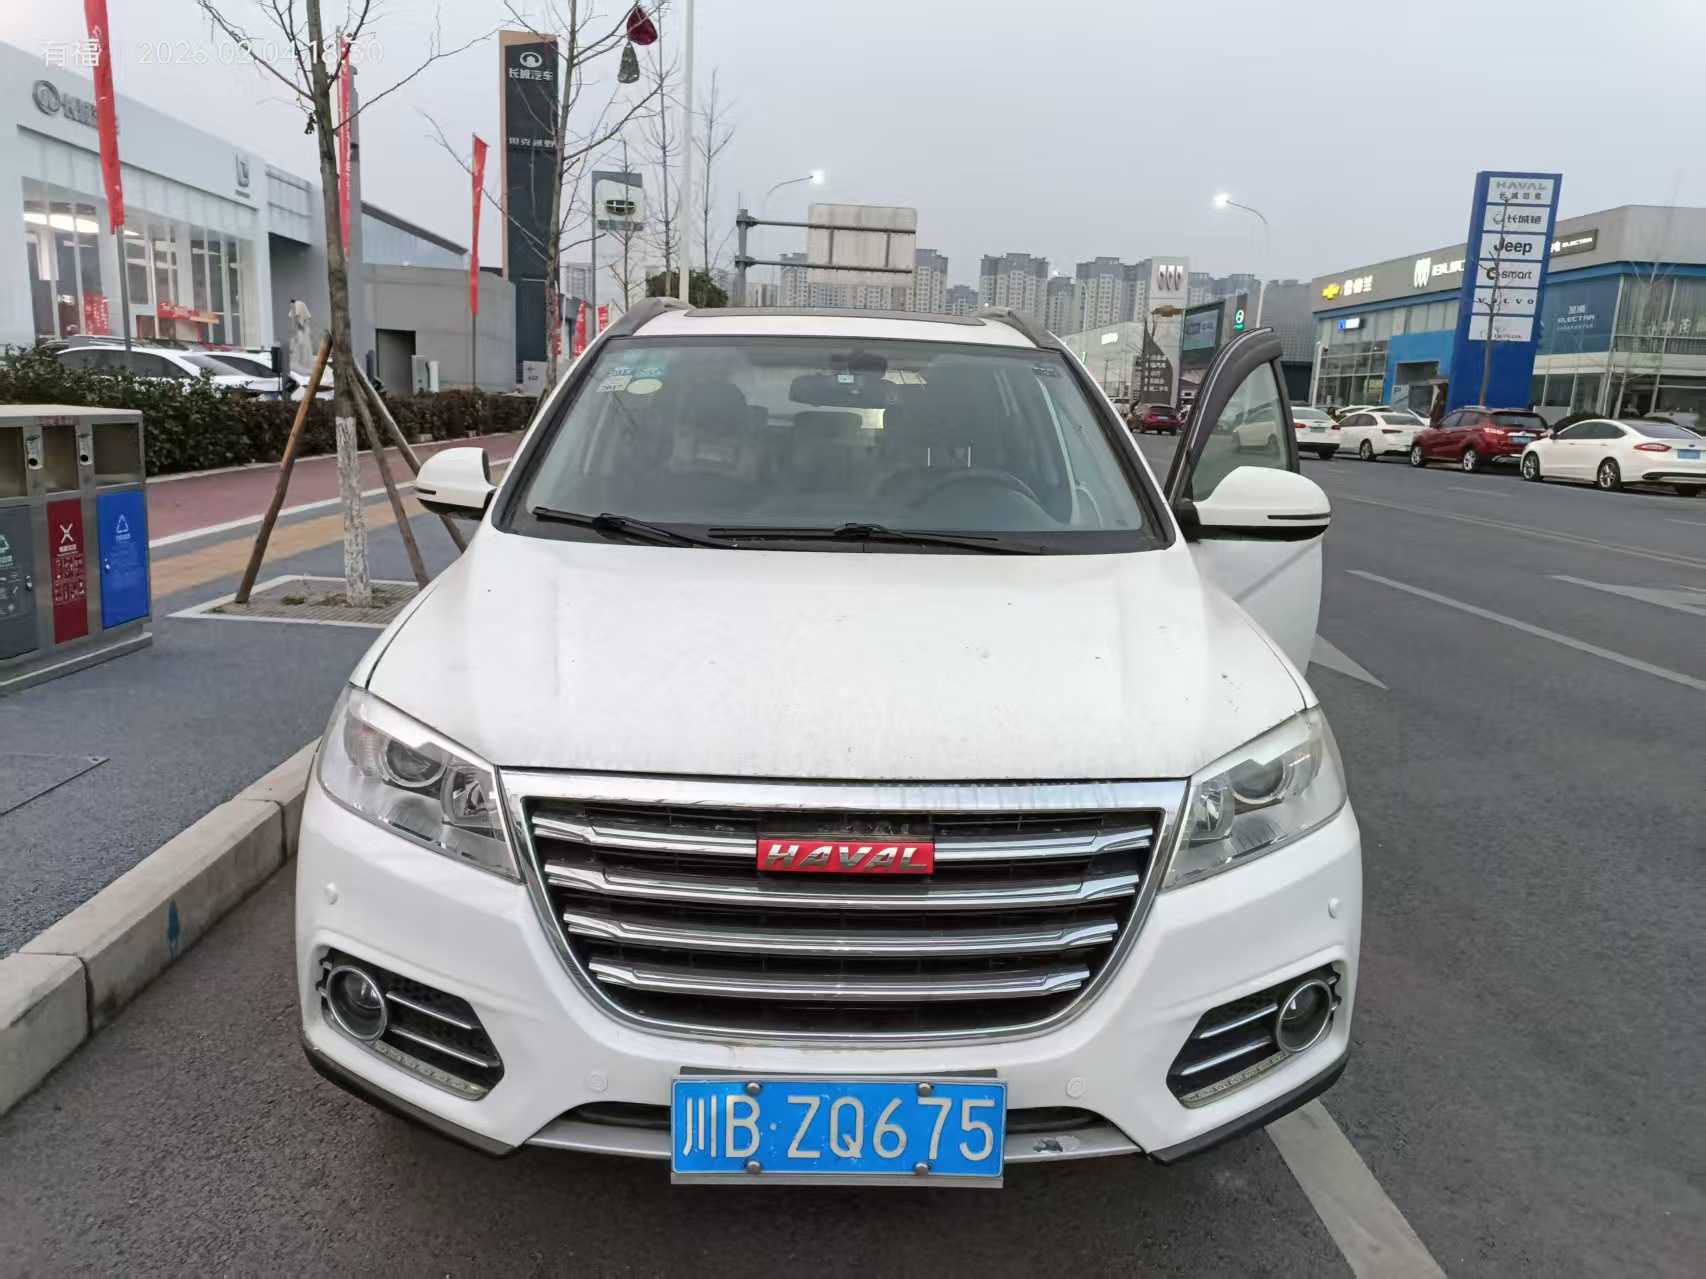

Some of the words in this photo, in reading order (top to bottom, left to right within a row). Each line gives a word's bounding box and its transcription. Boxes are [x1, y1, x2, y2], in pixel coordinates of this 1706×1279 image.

[509, 68, 553, 80] 长城汽车
[1496, 181, 1546, 190] HAVAL
[1494, 236, 1533, 256] Jeep
[1501, 270, 1533, 280] smart
[764, 844, 929, 870] HAVAL
